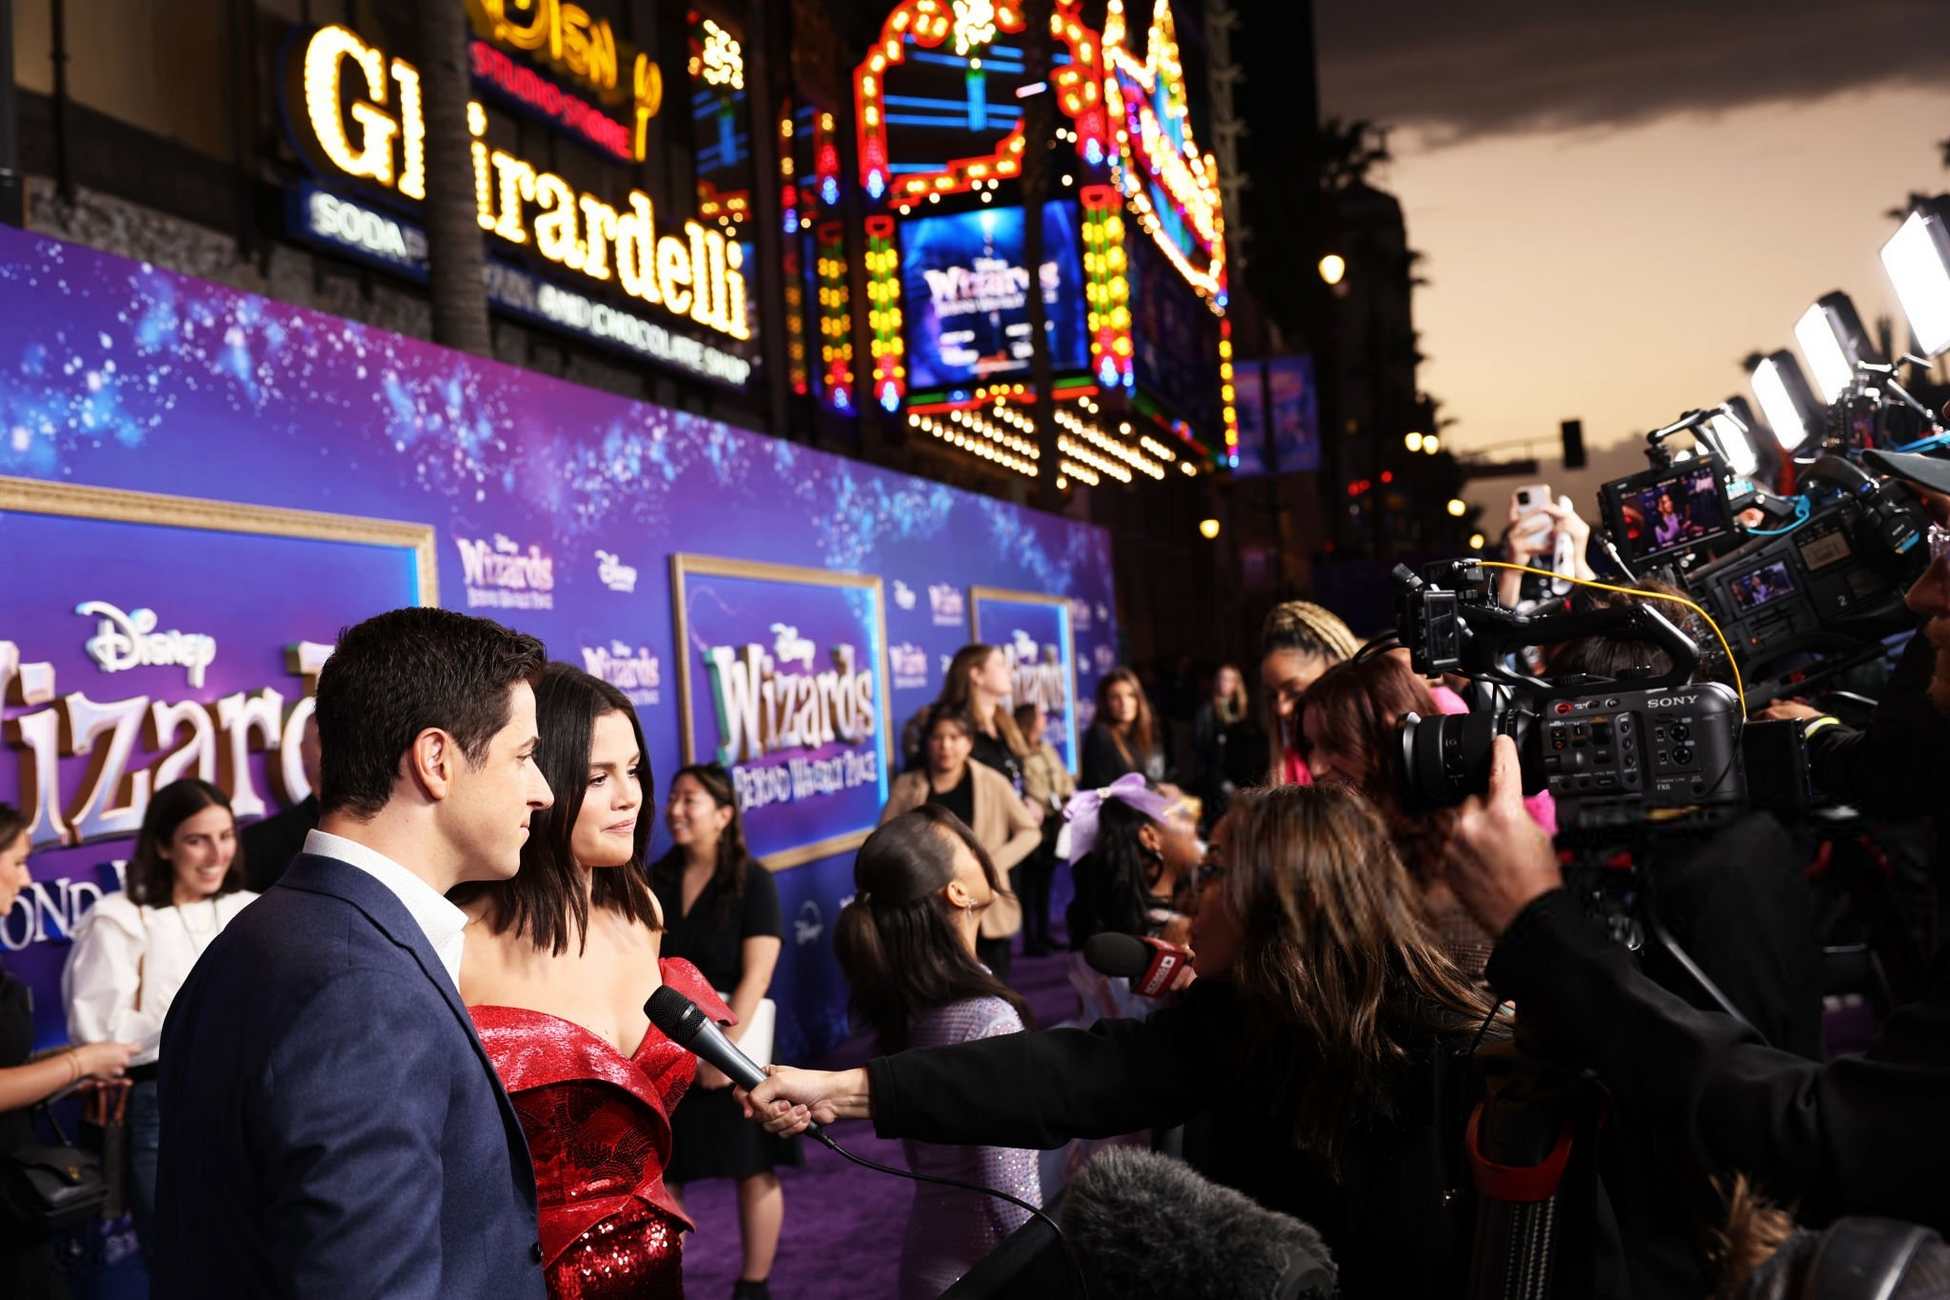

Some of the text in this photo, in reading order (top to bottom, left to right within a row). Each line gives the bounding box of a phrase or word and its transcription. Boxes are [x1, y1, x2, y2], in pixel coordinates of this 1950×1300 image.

[308, 191, 407, 261] SODA
[75, 600, 217, 688] Disney
[0, 636, 335, 846] izar
[704, 642, 877, 766] Wizards
[1648, 695, 1699, 709] SONY
[0, 876, 104, 951] OND
